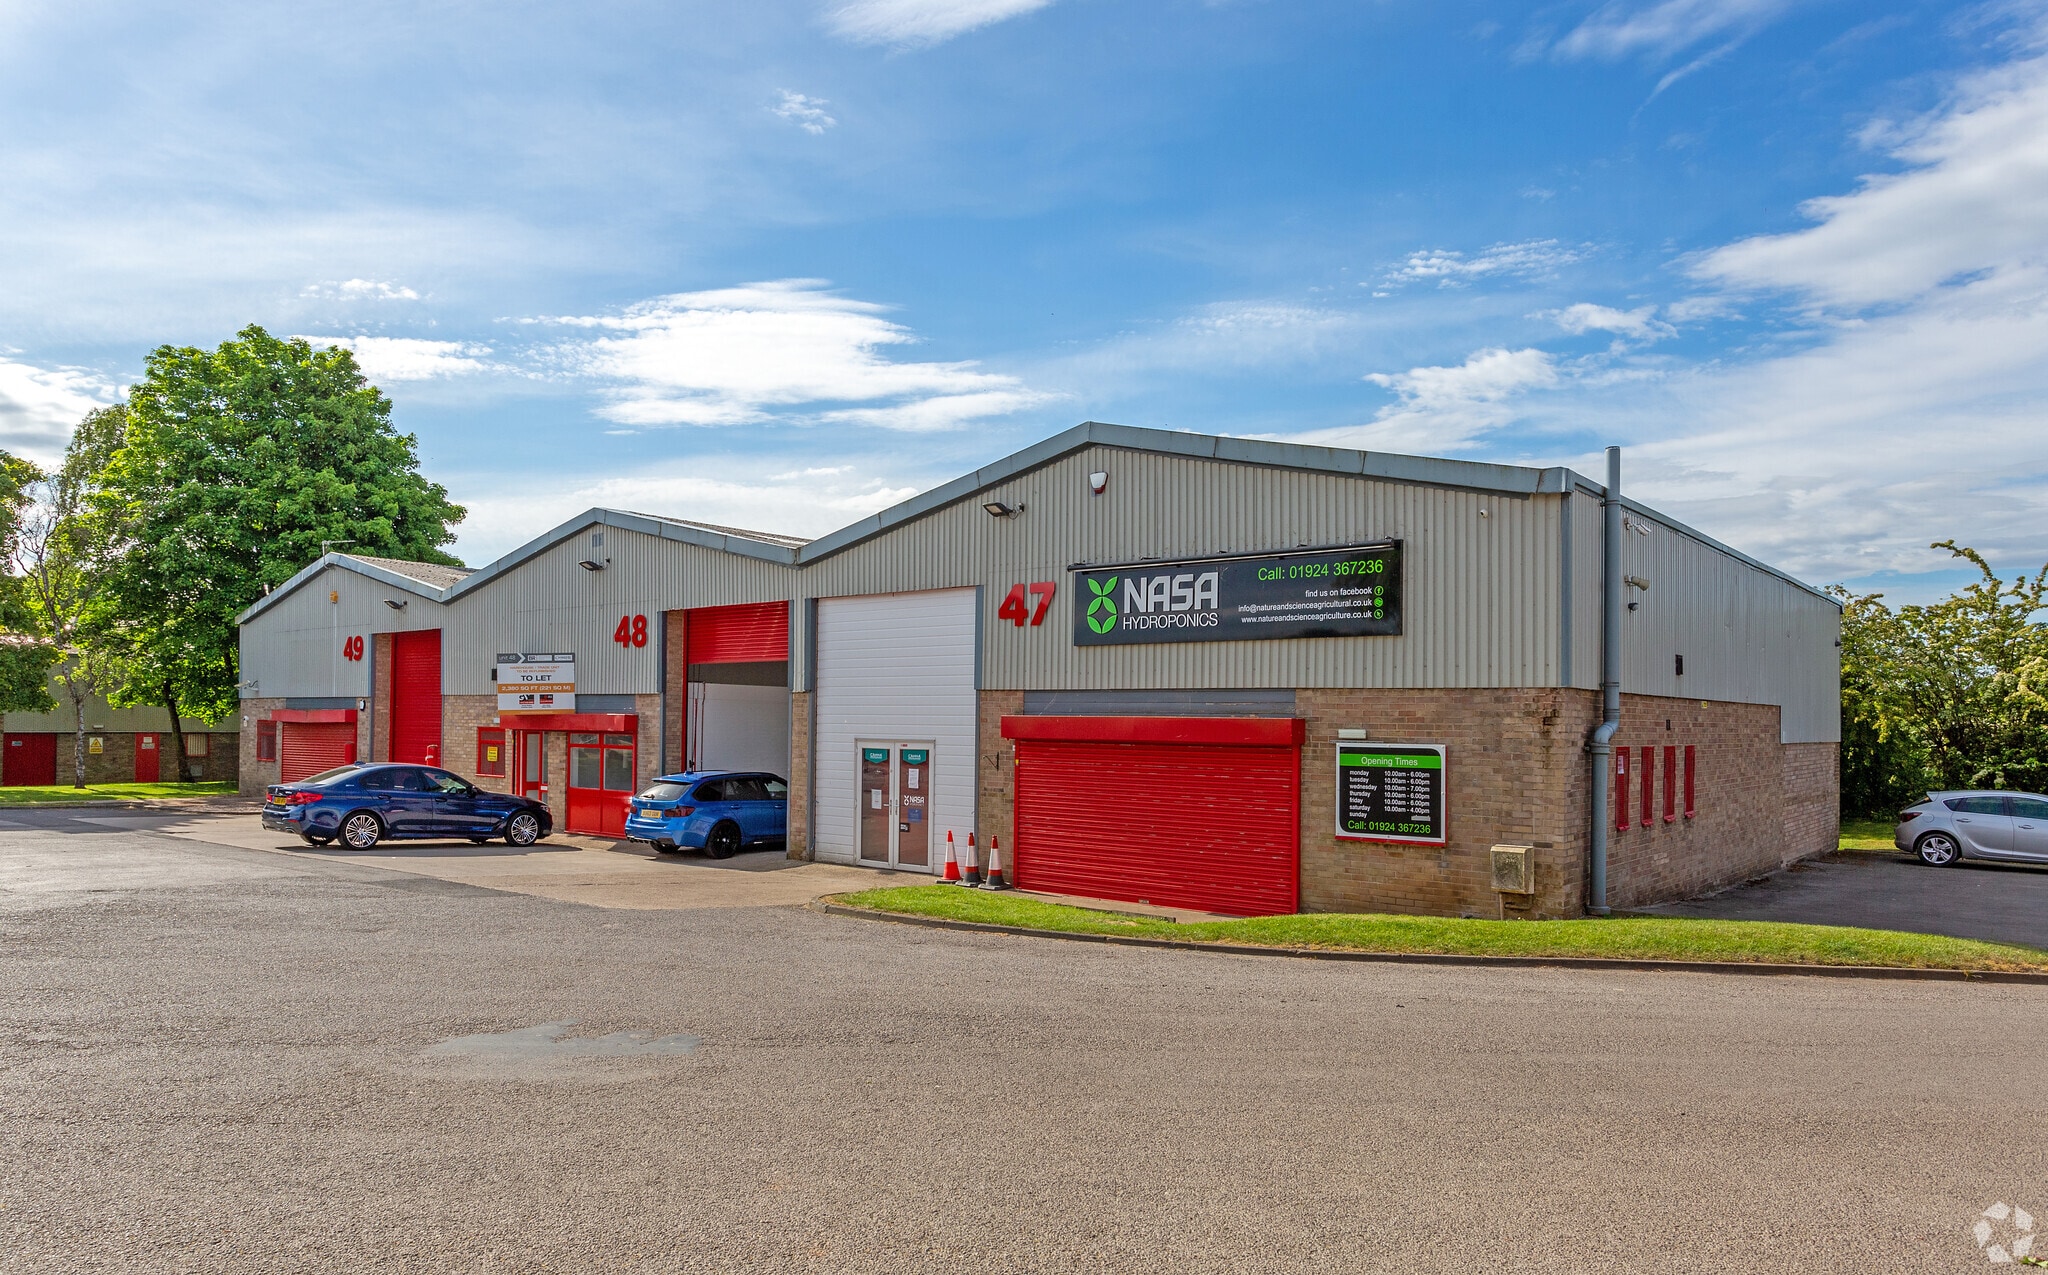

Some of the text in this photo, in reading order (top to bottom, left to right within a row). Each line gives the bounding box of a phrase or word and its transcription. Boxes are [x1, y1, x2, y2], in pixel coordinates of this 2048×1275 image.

[1258, 559, 1383, 580] Call: 01924 367236
[1124, 572, 1218, 614] NASA
[1305, 590, 1318, 598] find
[1340, 586, 1372, 596] facebook
[998, 581, 1056, 627] 47
[1238, 598, 1372, 613] info@natureandscienceagricultural.co.uk
[1123, 612, 1218, 630] HYDROPONICS
[1241, 610, 1372, 623] www.natureandscienceagriculture.co.uk
[614, 614, 647, 648] 48
[344, 635, 364, 662] 49
[1361, 757, 1418, 766] Opening Times
[1348, 820, 1431, 833] Call: 01924 367236
